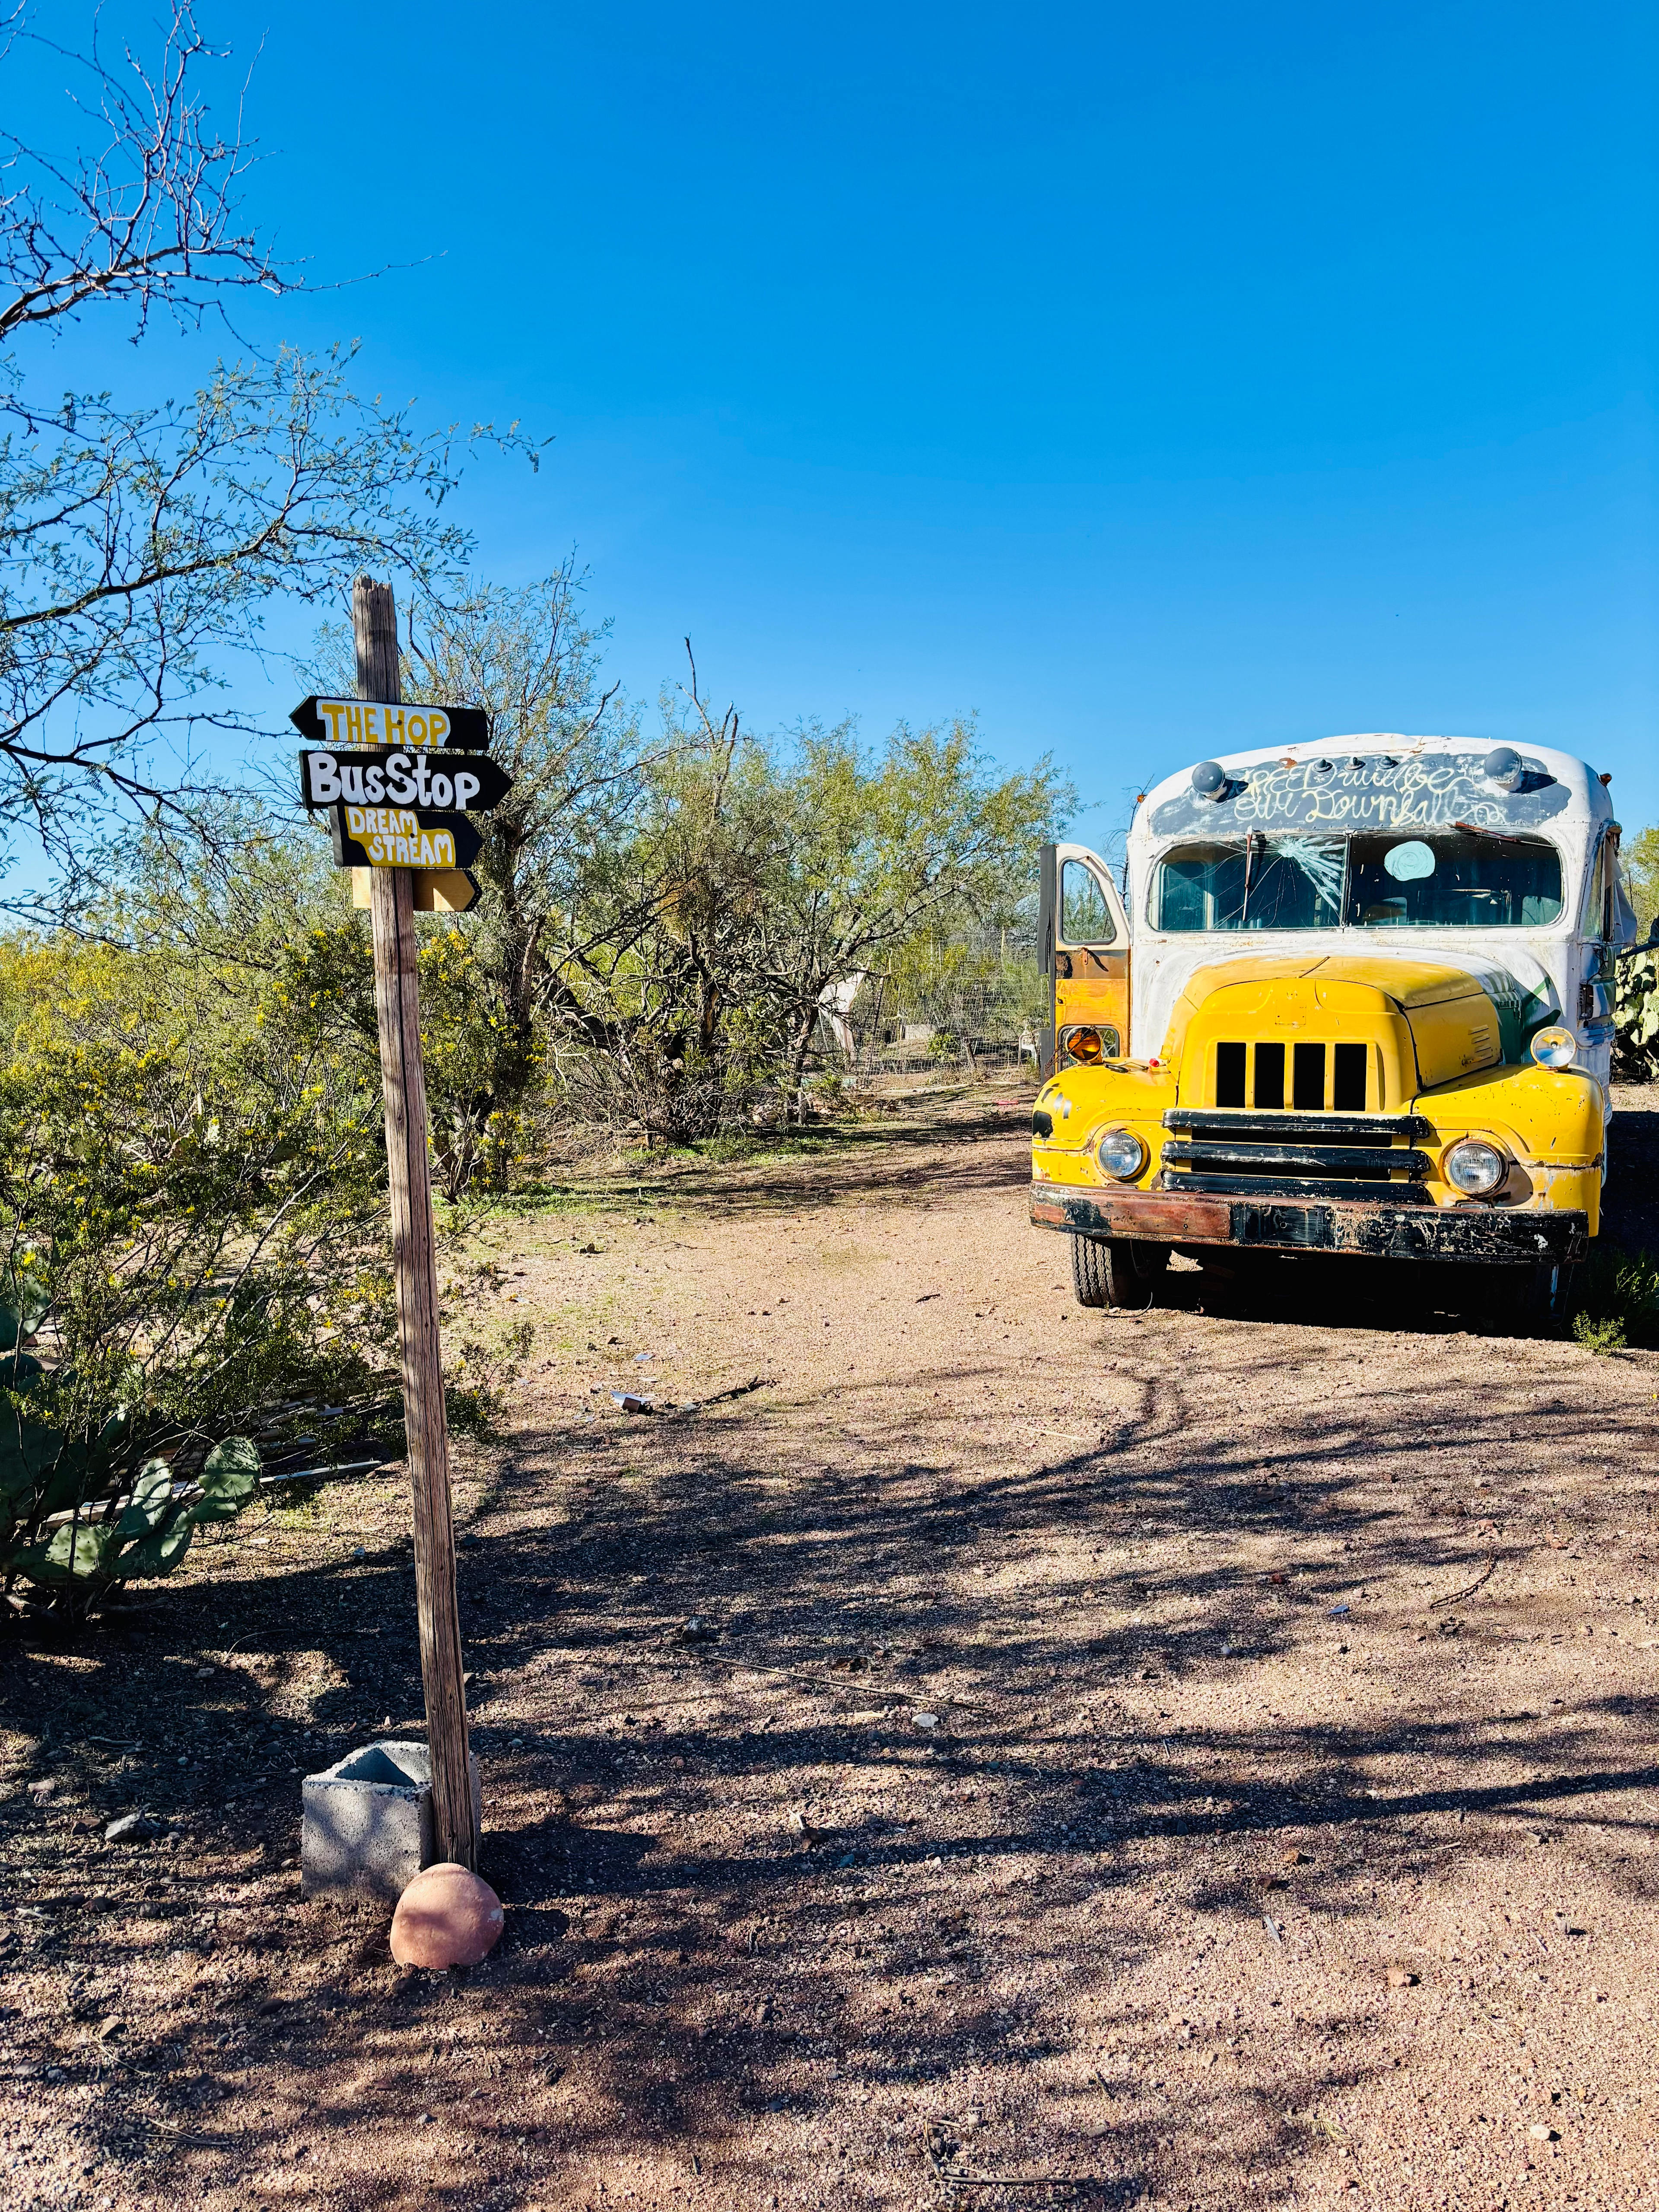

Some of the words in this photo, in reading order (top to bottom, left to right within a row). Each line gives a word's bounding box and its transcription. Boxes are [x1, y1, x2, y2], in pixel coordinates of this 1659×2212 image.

[321, 703, 379, 744] THE
[384, 707, 448, 747] HOP
[348, 807, 417, 835] DREAM
[369, 832, 452, 864] STREAM
